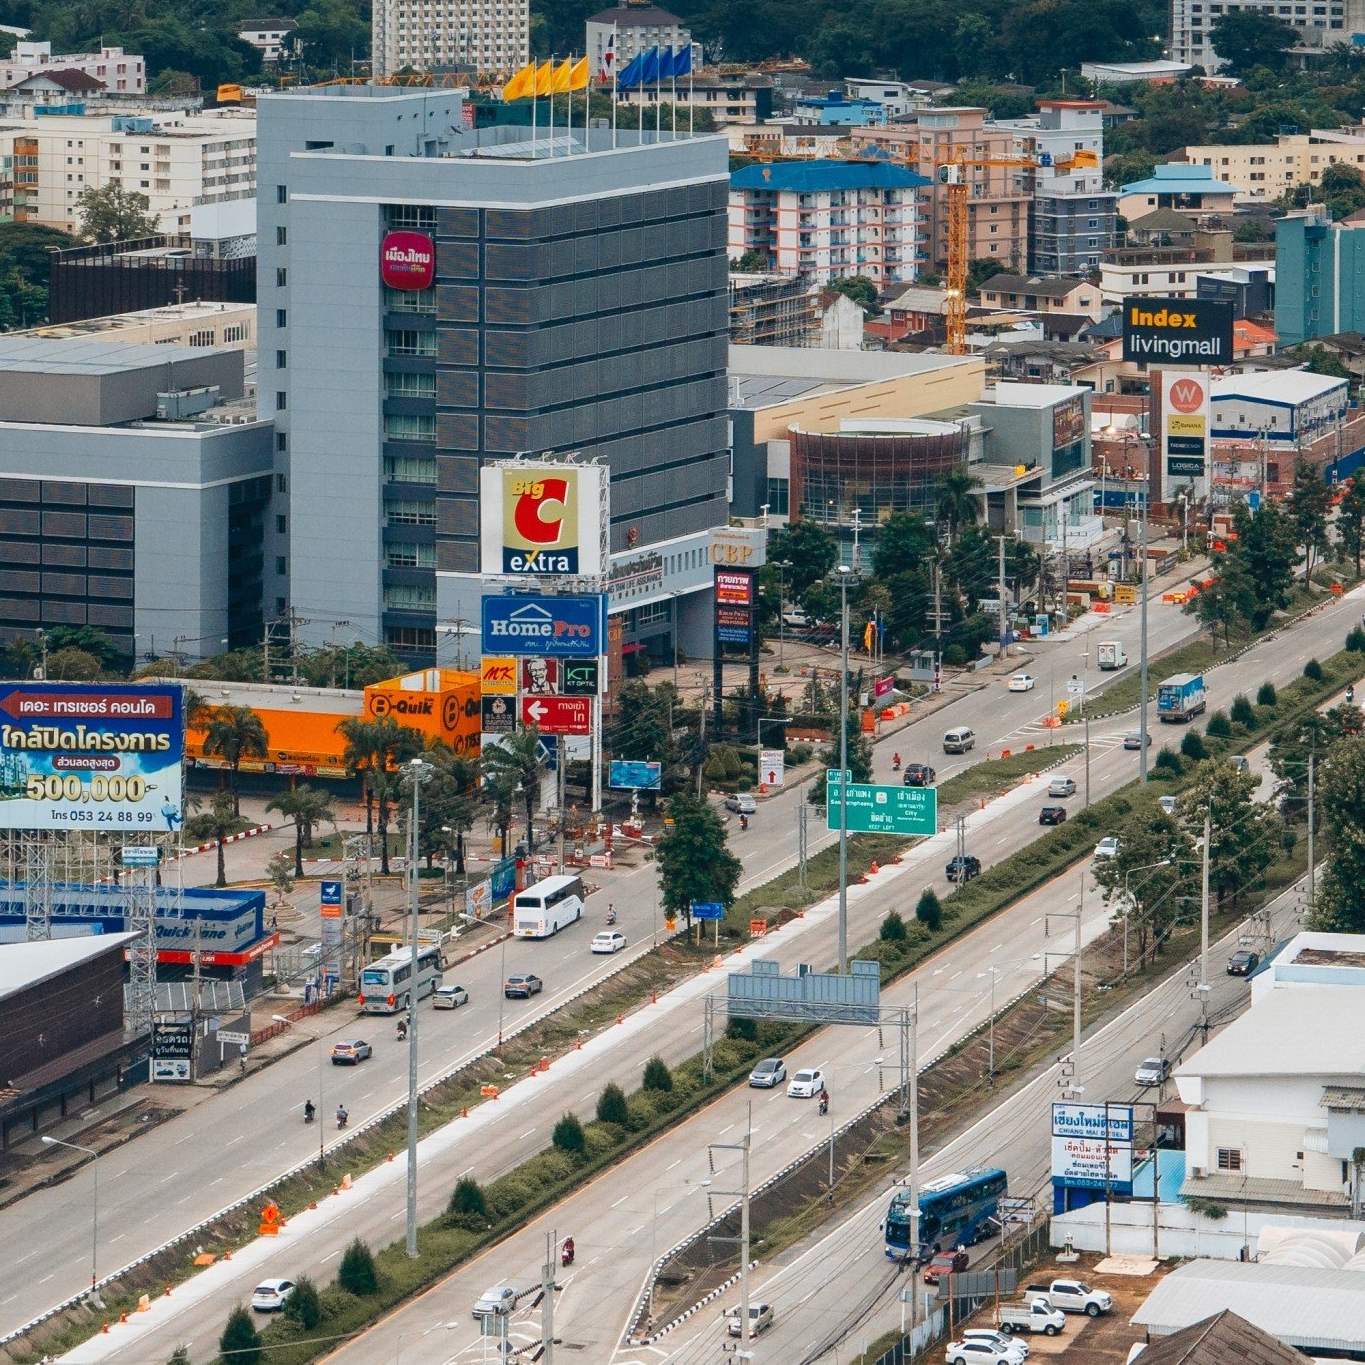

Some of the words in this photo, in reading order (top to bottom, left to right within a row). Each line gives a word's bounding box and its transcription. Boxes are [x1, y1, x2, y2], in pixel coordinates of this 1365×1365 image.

[385, 246, 430, 263] เมืองไทย
[1131, 307, 1197, 328] Index
[1131, 334, 1221, 358] livingmall
[512, 479, 545, 500] Big
[513, 477, 570, 545] C
[510, 548, 570, 571] extra
[709, 543, 754, 565] CBP
[483, 666, 515, 681] MK
[567, 667, 596, 681] KT
[19, 700, 50, 713] เดอะ
[53, 698, 108, 714] เทรเชอร์
[110, 698, 156, 715] คอนโด
[558, 700, 585, 711] ทางเข้า
[573, 711, 585, 722] In
[1, 724, 171, 751] ใกล้ปิดโครงการ
[56, 755, 116, 770] ส่วนลดสูงสุด
[51, 809, 68, 820] โทร
[69, 811, 94, 822] 053
[97, 811, 113, 822] 24
[117, 811, 133, 822] 88
[137, 812, 153, 822] 99
[155, 924, 192, 939] Quick
[1058, 1127, 1084, 1135] CHIANG
